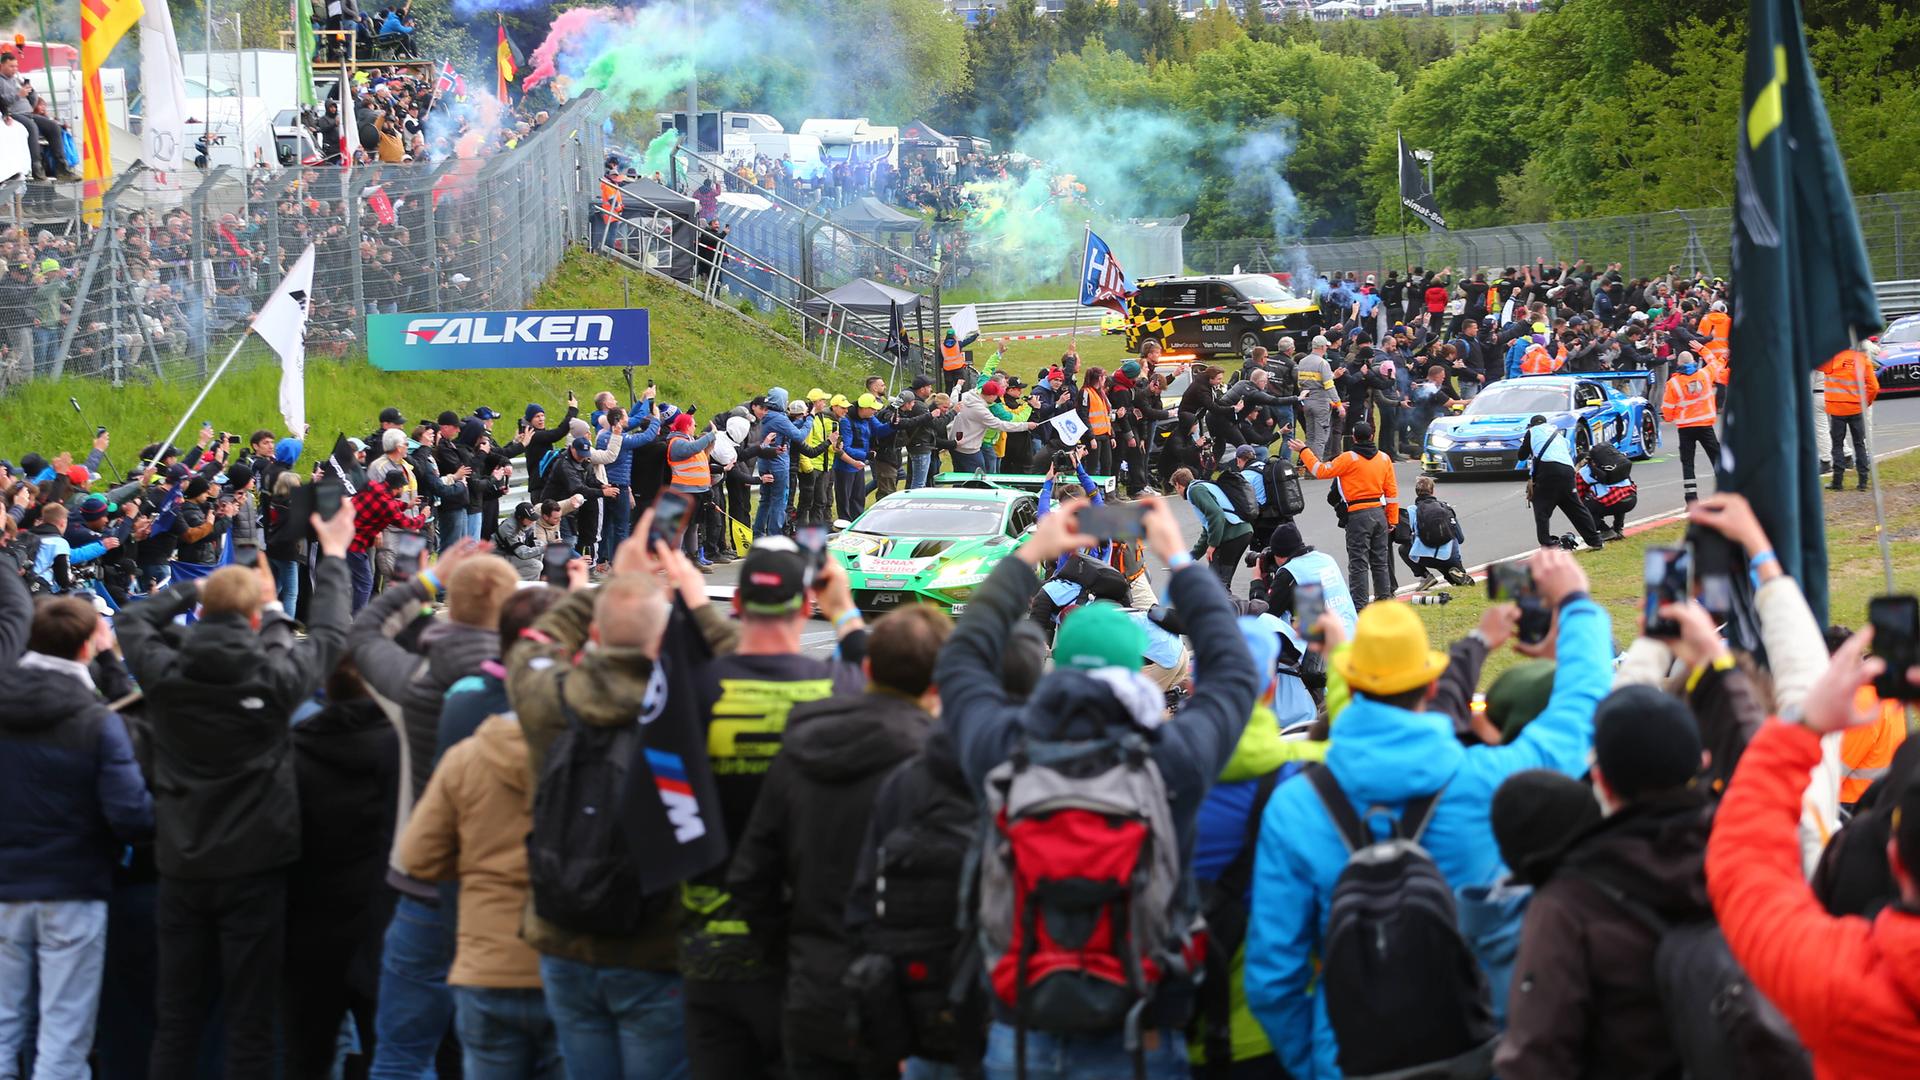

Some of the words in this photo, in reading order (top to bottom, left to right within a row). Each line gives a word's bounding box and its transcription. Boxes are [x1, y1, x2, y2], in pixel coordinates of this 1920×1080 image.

[198, 135, 228, 146] SXT
[1402, 196, 1446, 227] eimat-Box
[1201, 317, 1230, 325] MOBILITÄT
[403, 315, 614, 345] FALKEN
[555, 346, 609, 361] TYRES
[872, 558, 915, 566] SONAX
[871, 592, 901, 605] ABT
